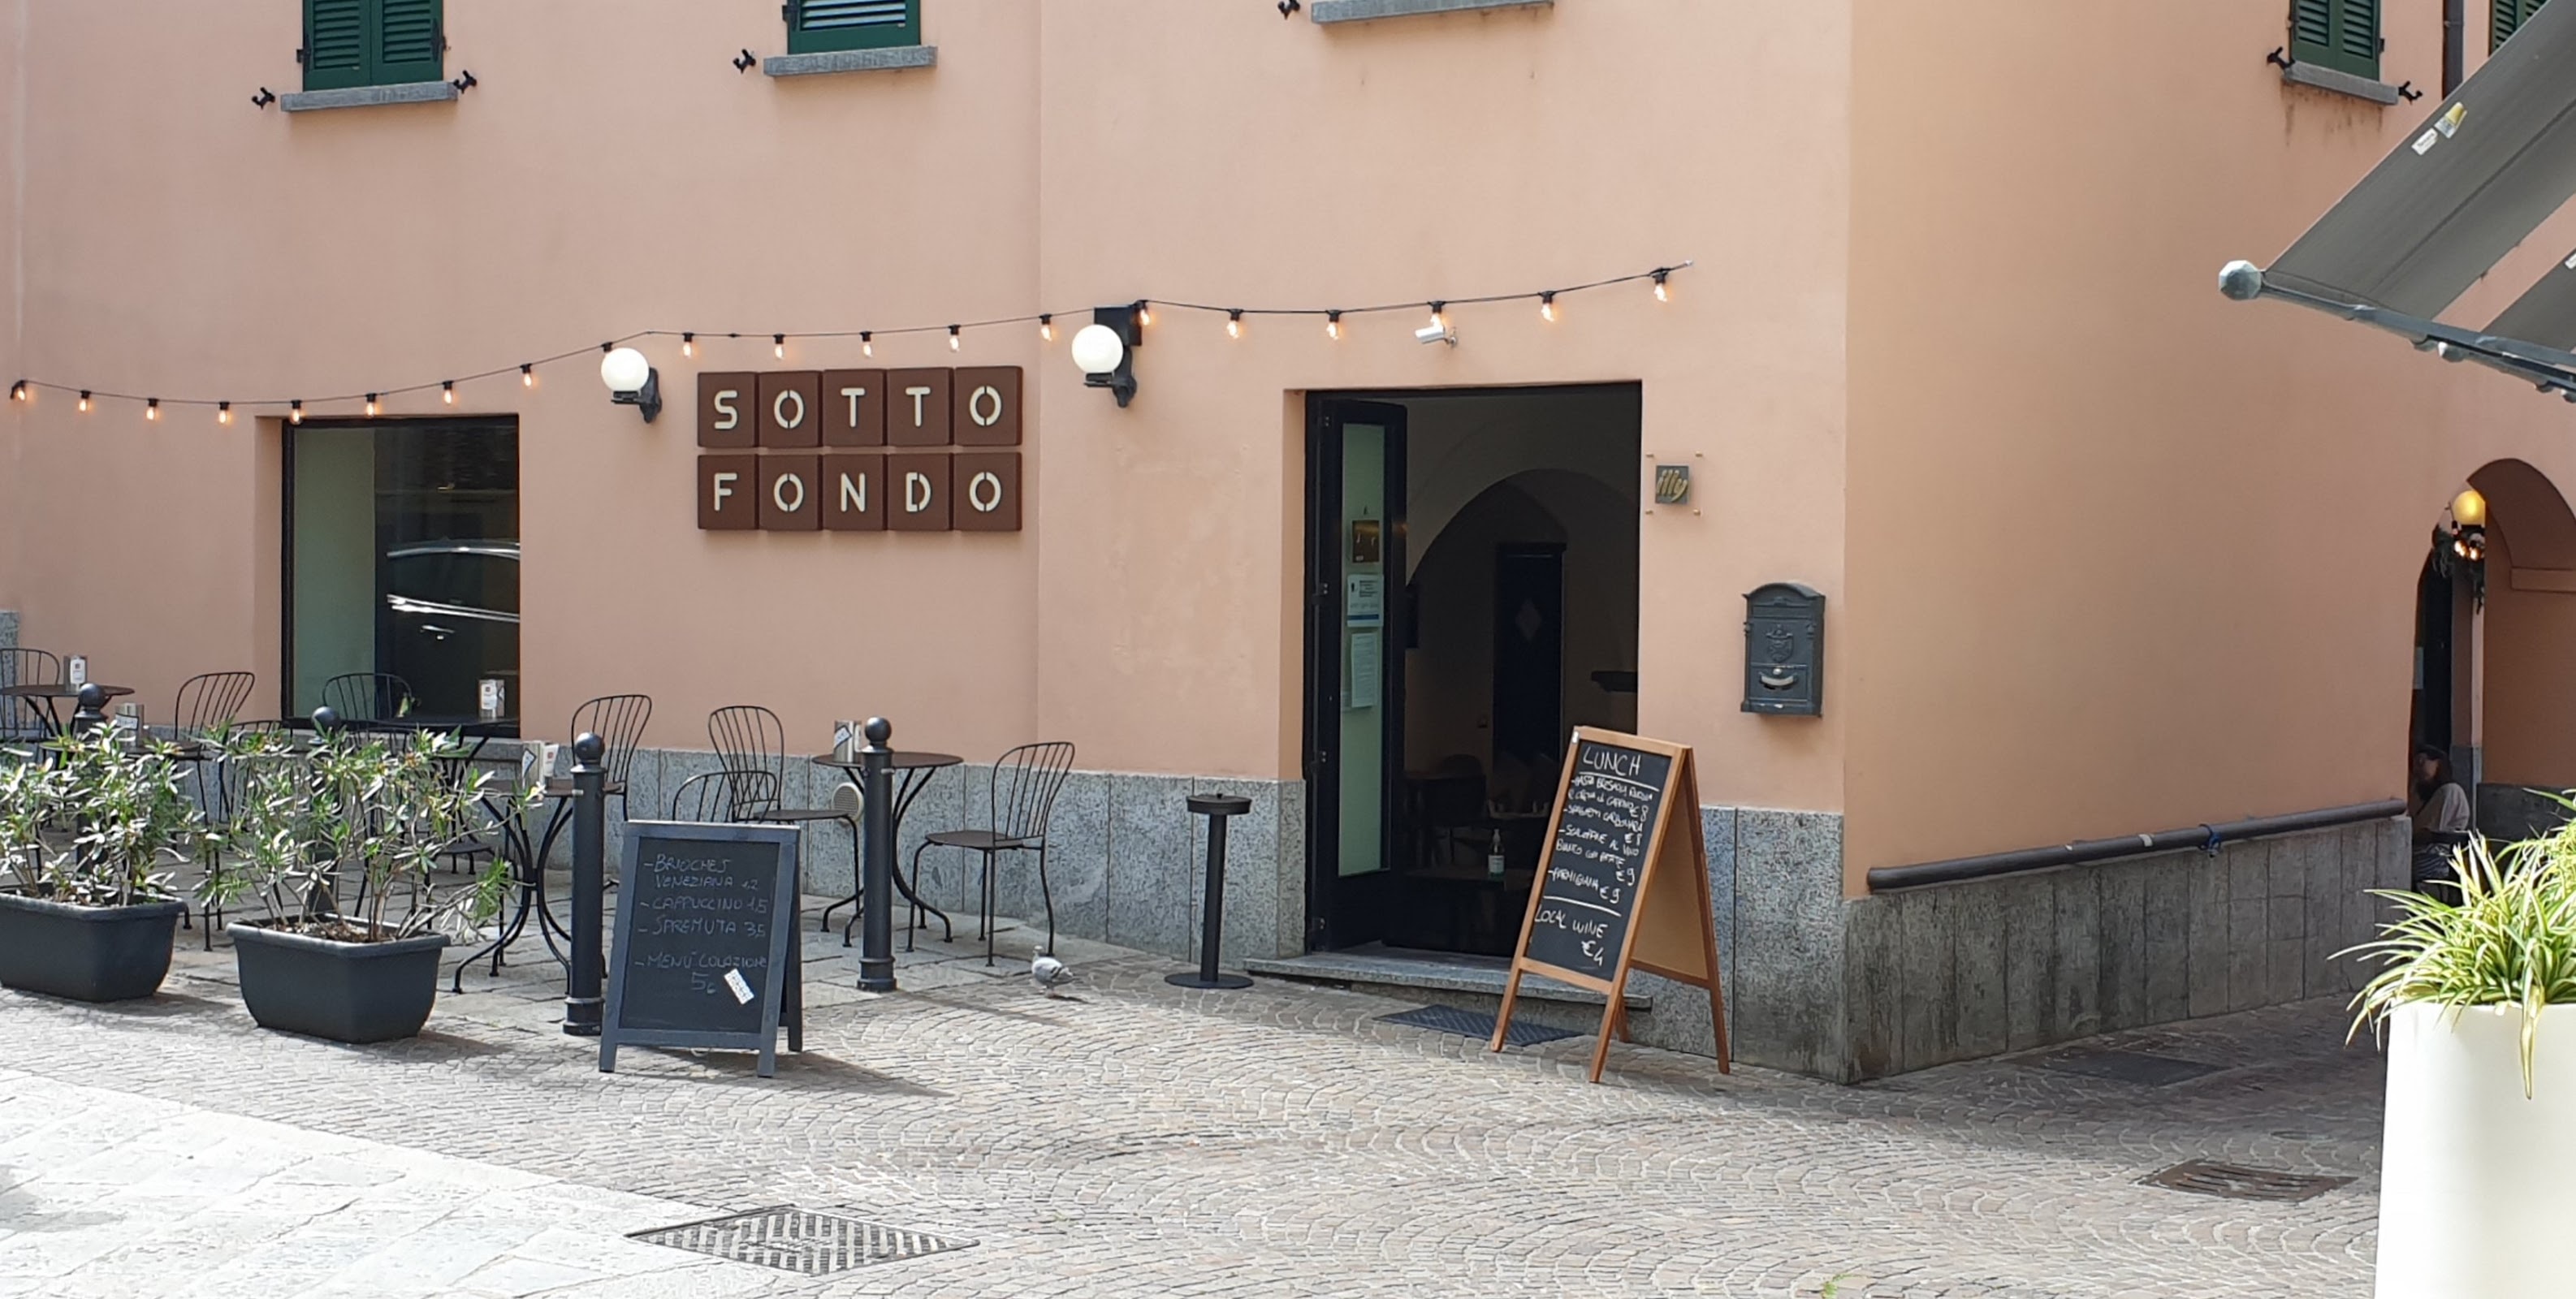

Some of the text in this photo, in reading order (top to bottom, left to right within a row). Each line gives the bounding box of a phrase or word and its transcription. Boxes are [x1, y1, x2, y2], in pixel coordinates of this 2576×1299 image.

[714, 385, 1002, 429] SOTTO
[714, 472, 1001, 512] FONDO
[1583, 746, 1641, 776] LUNCH
[655, 874, 733, 889] VENEZIANA
[1534, 904, 1608, 939] LOCAL WINE
